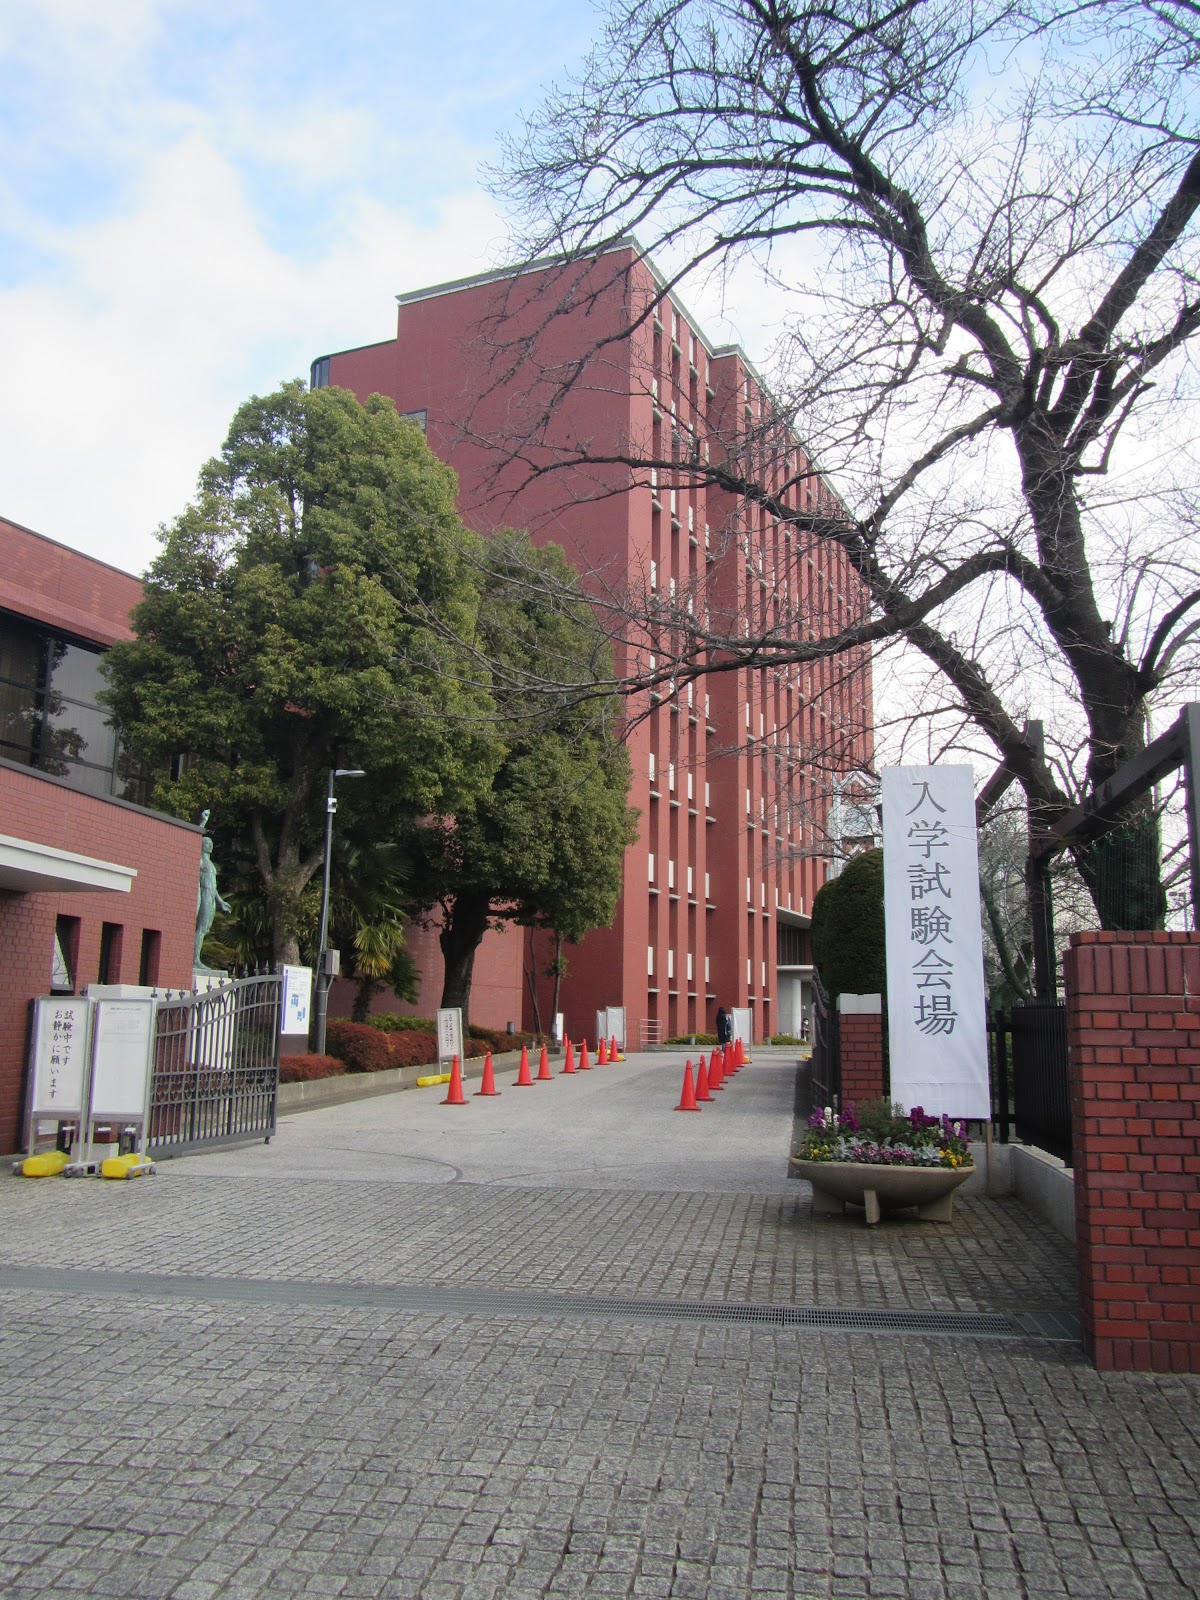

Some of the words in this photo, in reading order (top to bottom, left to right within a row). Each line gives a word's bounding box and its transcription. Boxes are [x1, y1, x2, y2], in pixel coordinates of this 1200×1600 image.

[905, 781, 959, 1036] 入学試験会場
[49, 1010, 63, 1100] お静かに願います
[61, 1010, 74, 1067] 試験中です
